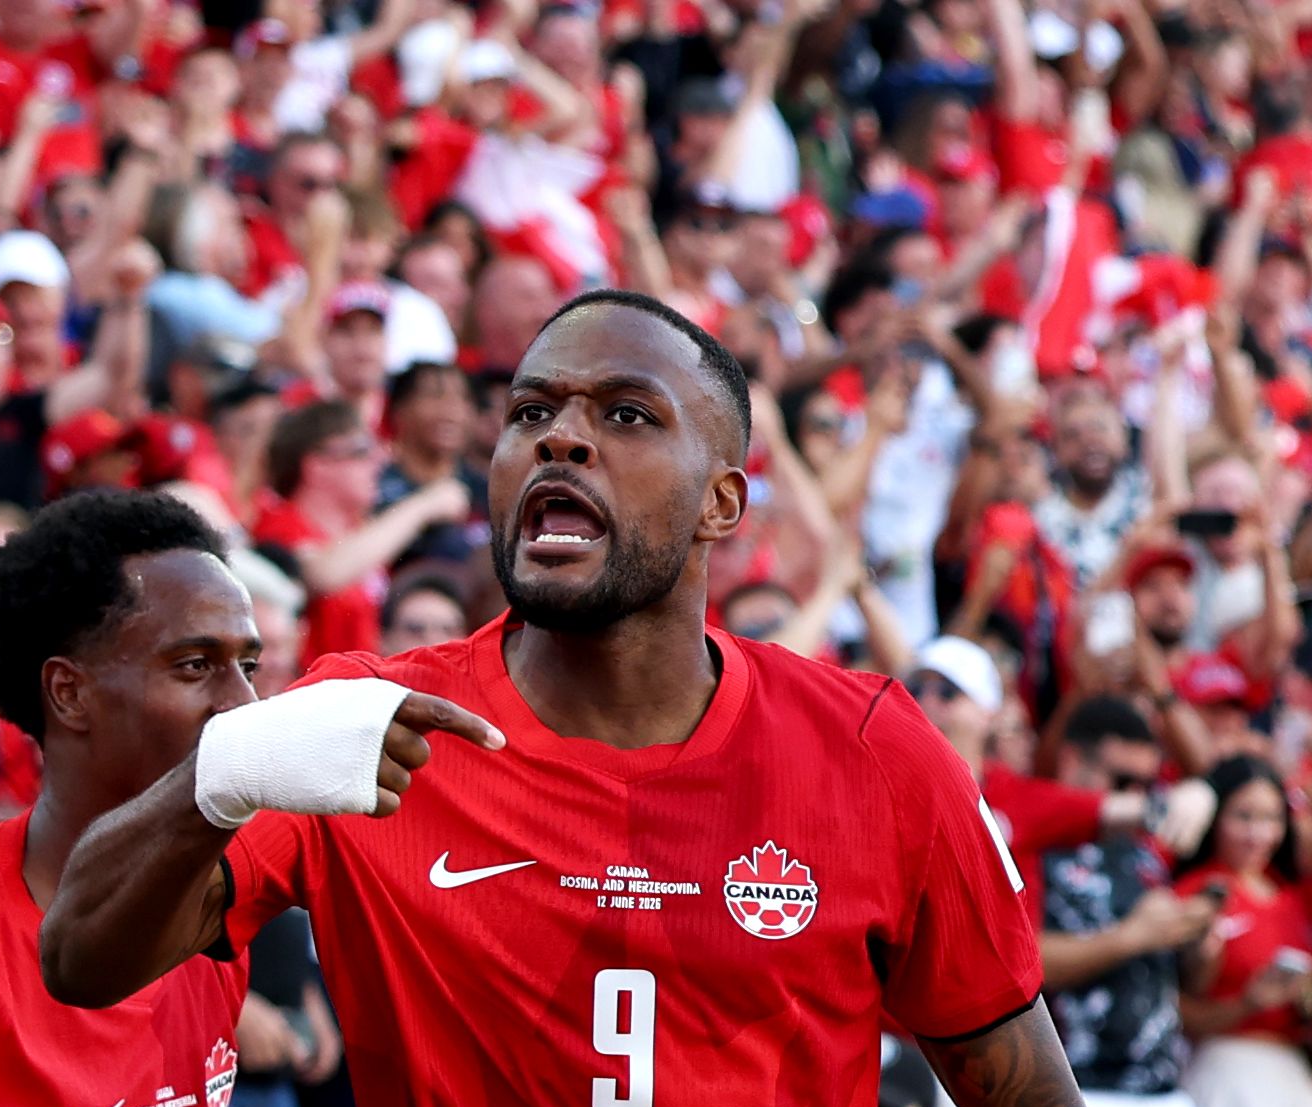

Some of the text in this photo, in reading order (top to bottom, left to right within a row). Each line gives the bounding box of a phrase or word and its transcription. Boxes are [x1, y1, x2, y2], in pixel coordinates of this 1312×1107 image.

[606, 865, 650, 879] CANADA
[559, 875, 701, 895] BOSNIA AND HERZEGOVINA
[726, 884, 815, 902] CANADA
[596, 895, 662, 910] 12 JUNE 2026
